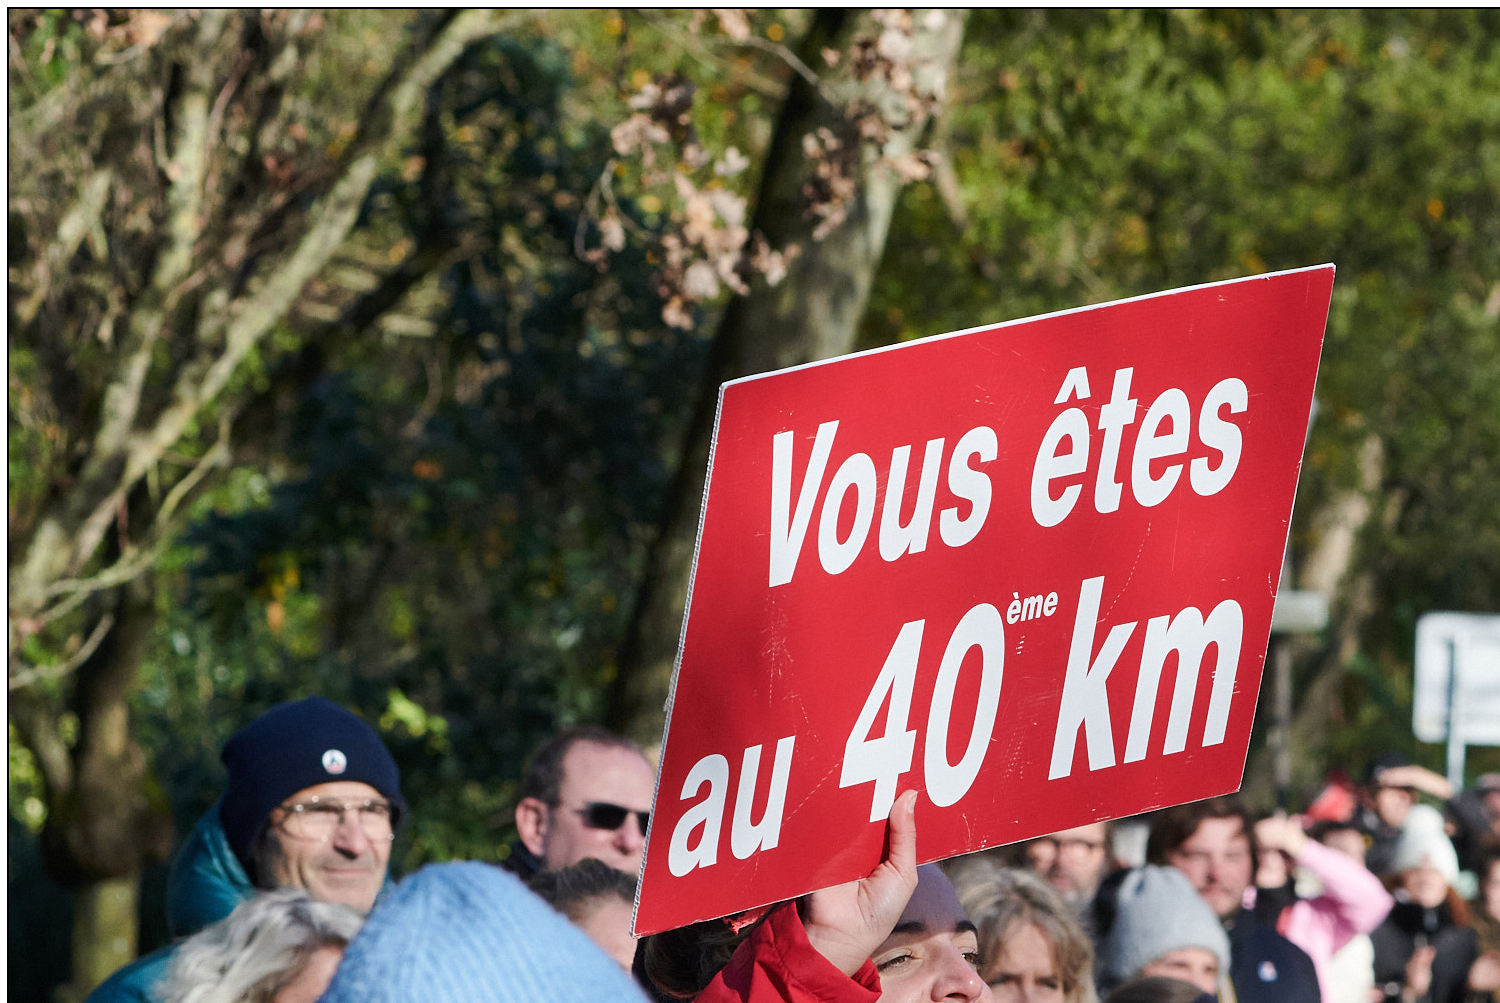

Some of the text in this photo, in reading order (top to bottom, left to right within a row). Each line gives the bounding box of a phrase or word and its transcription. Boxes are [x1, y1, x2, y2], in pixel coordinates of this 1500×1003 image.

[768, 366, 1249, 588] Vous êtes
[667, 735, 796, 878] au
[1048, 576, 1244, 781] km
